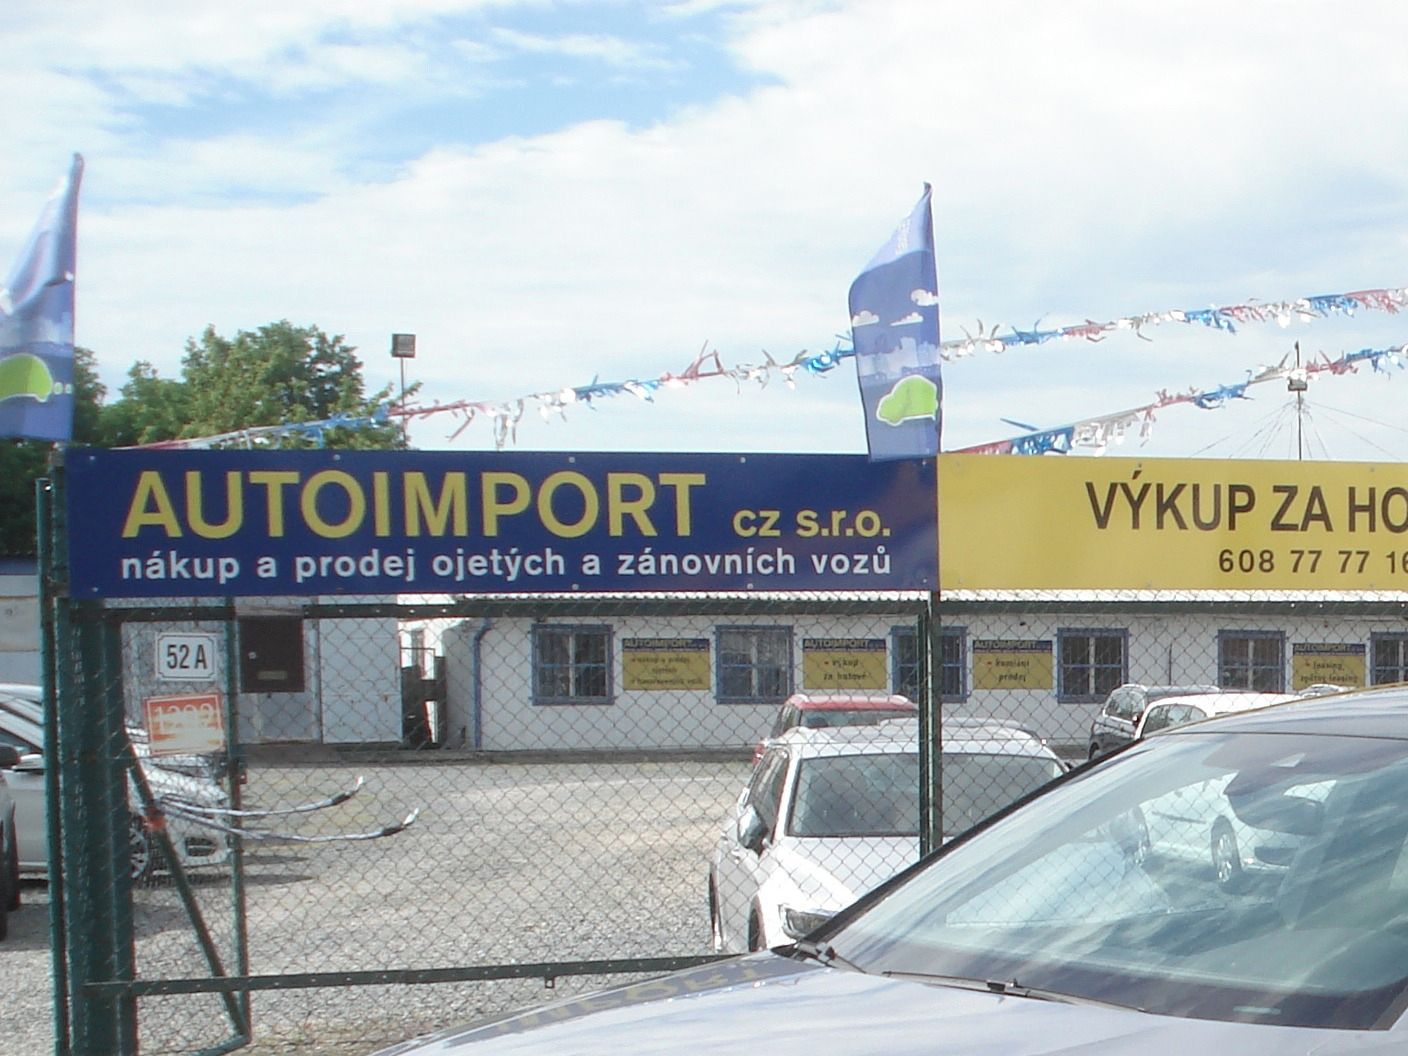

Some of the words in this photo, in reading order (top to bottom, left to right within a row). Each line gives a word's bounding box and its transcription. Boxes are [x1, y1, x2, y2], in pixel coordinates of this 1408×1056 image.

[121, 470, 706, 539] AUTOIMPORT
[732, 508, 781, 538] cz
[795, 507, 892, 538] s.r.o.
[1085, 471, 1255, 532] VÝKUP
[1271, 485, 1334, 533] ZA
[122, 549, 240, 583] nákup
[257, 555, 277, 577] a
[295, 548, 415, 583] prodej
[433, 546, 565, 582] ojetých
[581, 554, 601, 576] a
[618, 545, 796, 576] zánovních
[811, 545, 892, 575] vozů
[1218, 549, 1275, 574] 608
[1290, 549, 1322, 574] 77
[1338, 549, 1370, 574] 77
[166, 644, 190, 669] 52
[194, 644, 208, 669] A
